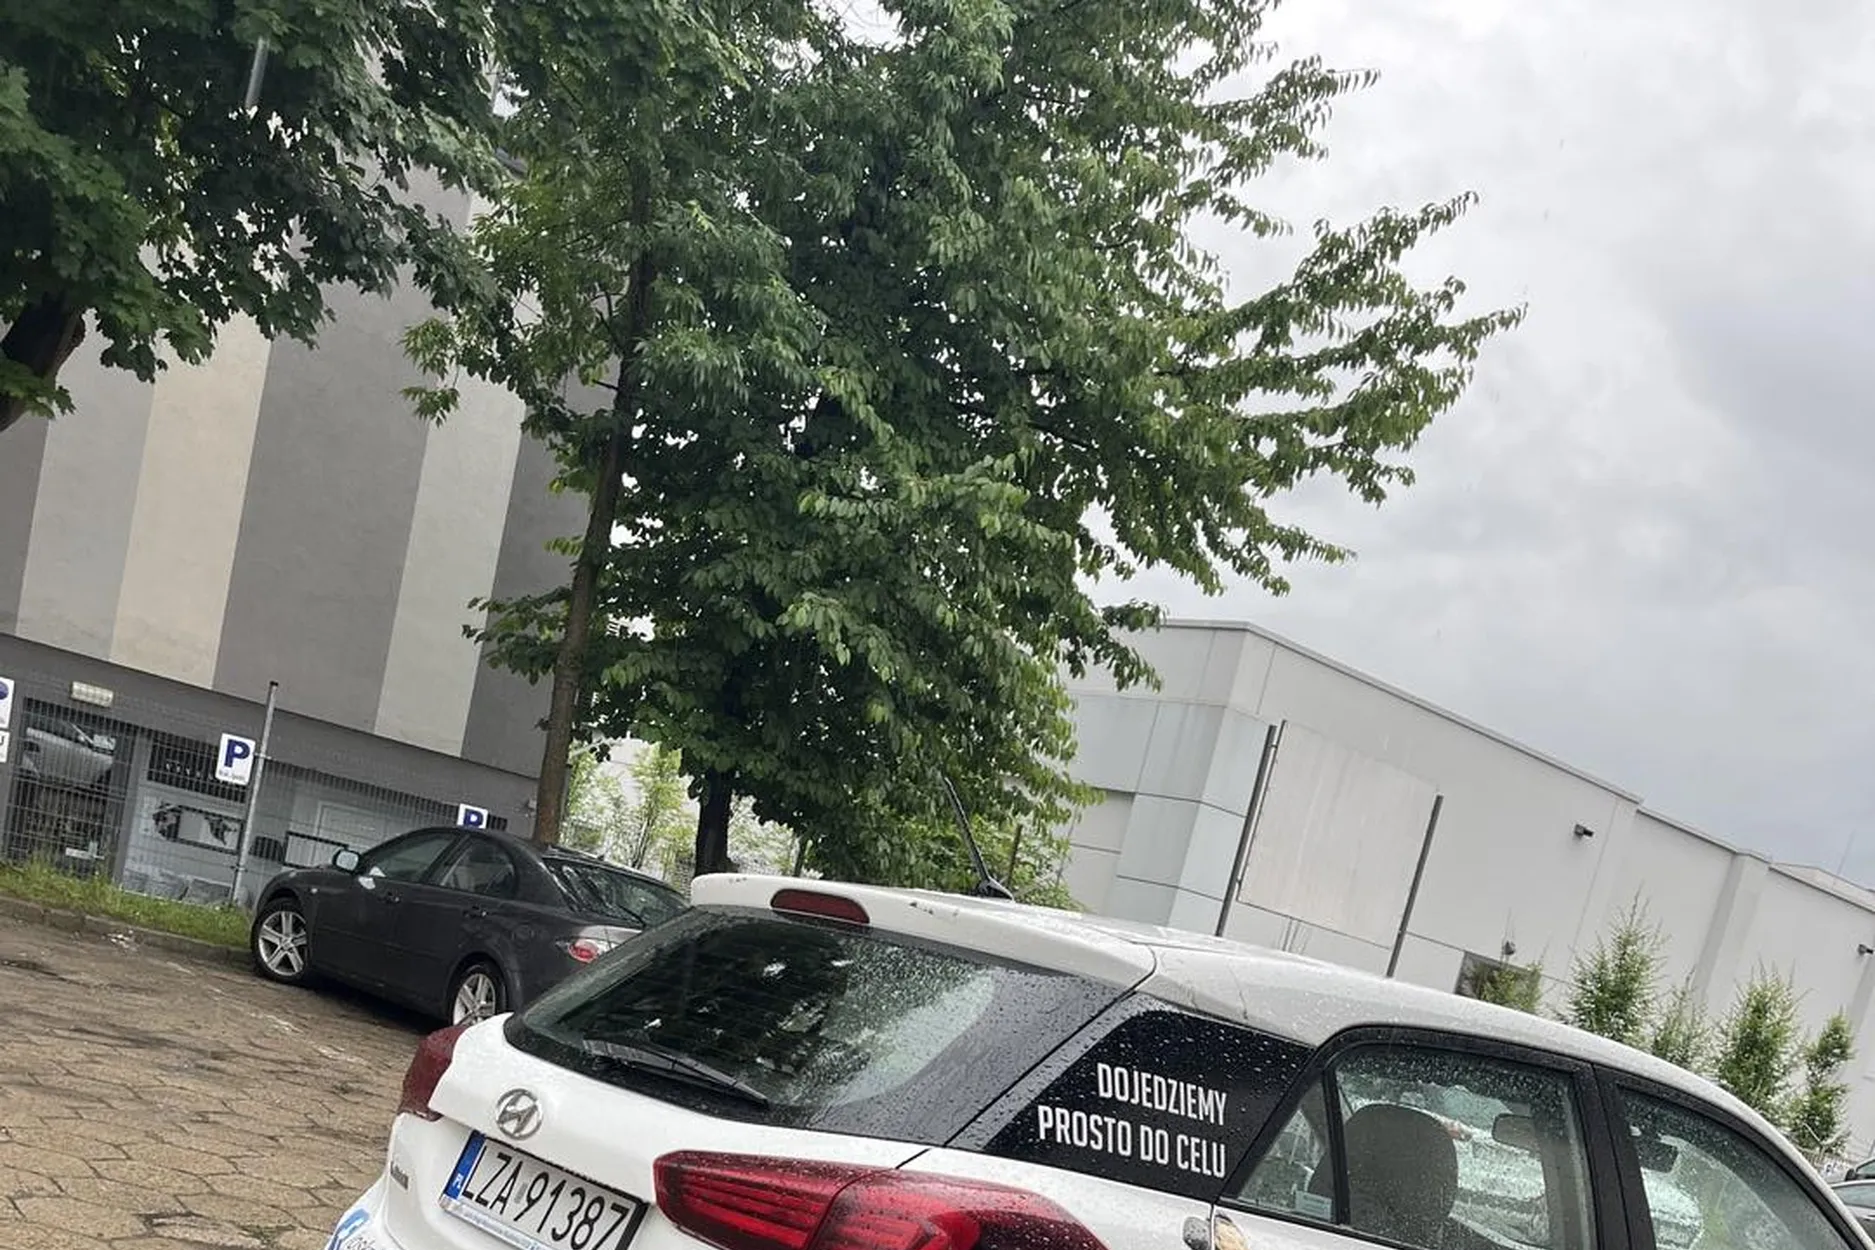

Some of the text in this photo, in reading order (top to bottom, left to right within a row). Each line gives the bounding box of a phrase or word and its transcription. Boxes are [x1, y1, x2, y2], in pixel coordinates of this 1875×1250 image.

[224, 739, 250, 768] P
[1097, 1062, 1227, 1125] DOJEDZIEMY
[1038, 1105, 1226, 1178] PROSTO DO CELU
[462, 1145, 523, 1215] LZA
